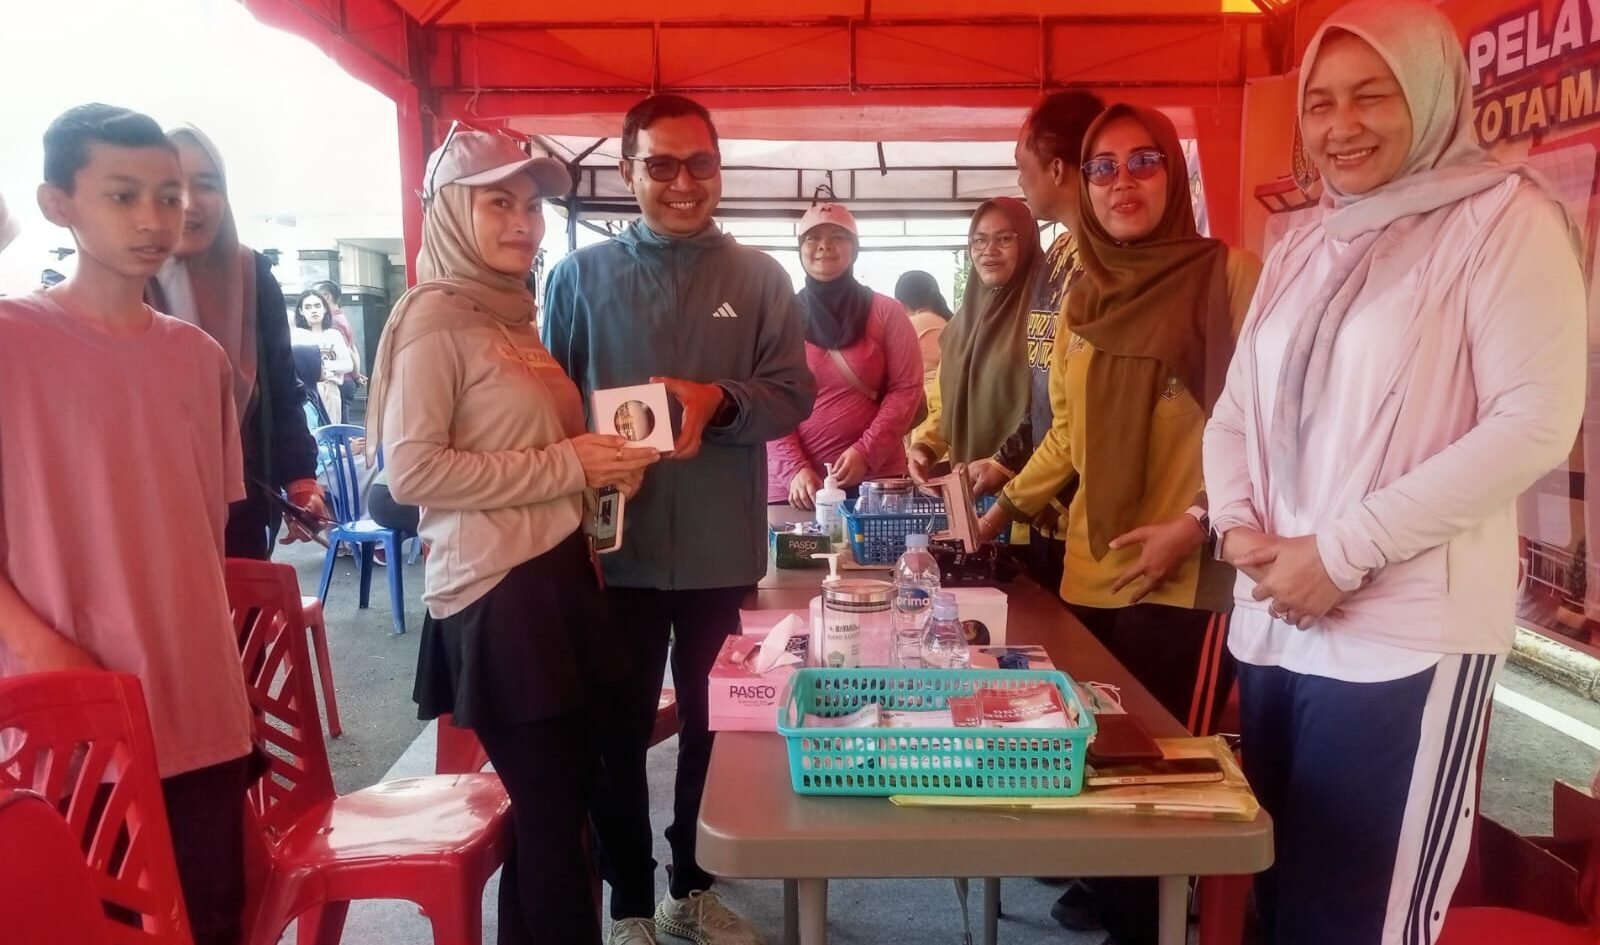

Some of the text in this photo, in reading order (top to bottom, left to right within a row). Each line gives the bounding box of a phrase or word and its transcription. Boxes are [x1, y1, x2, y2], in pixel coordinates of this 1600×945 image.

[1559, 69, 1600, 122] M
[788, 540, 817, 550] PASEO
[729, 685, 776, 699] PASEO
